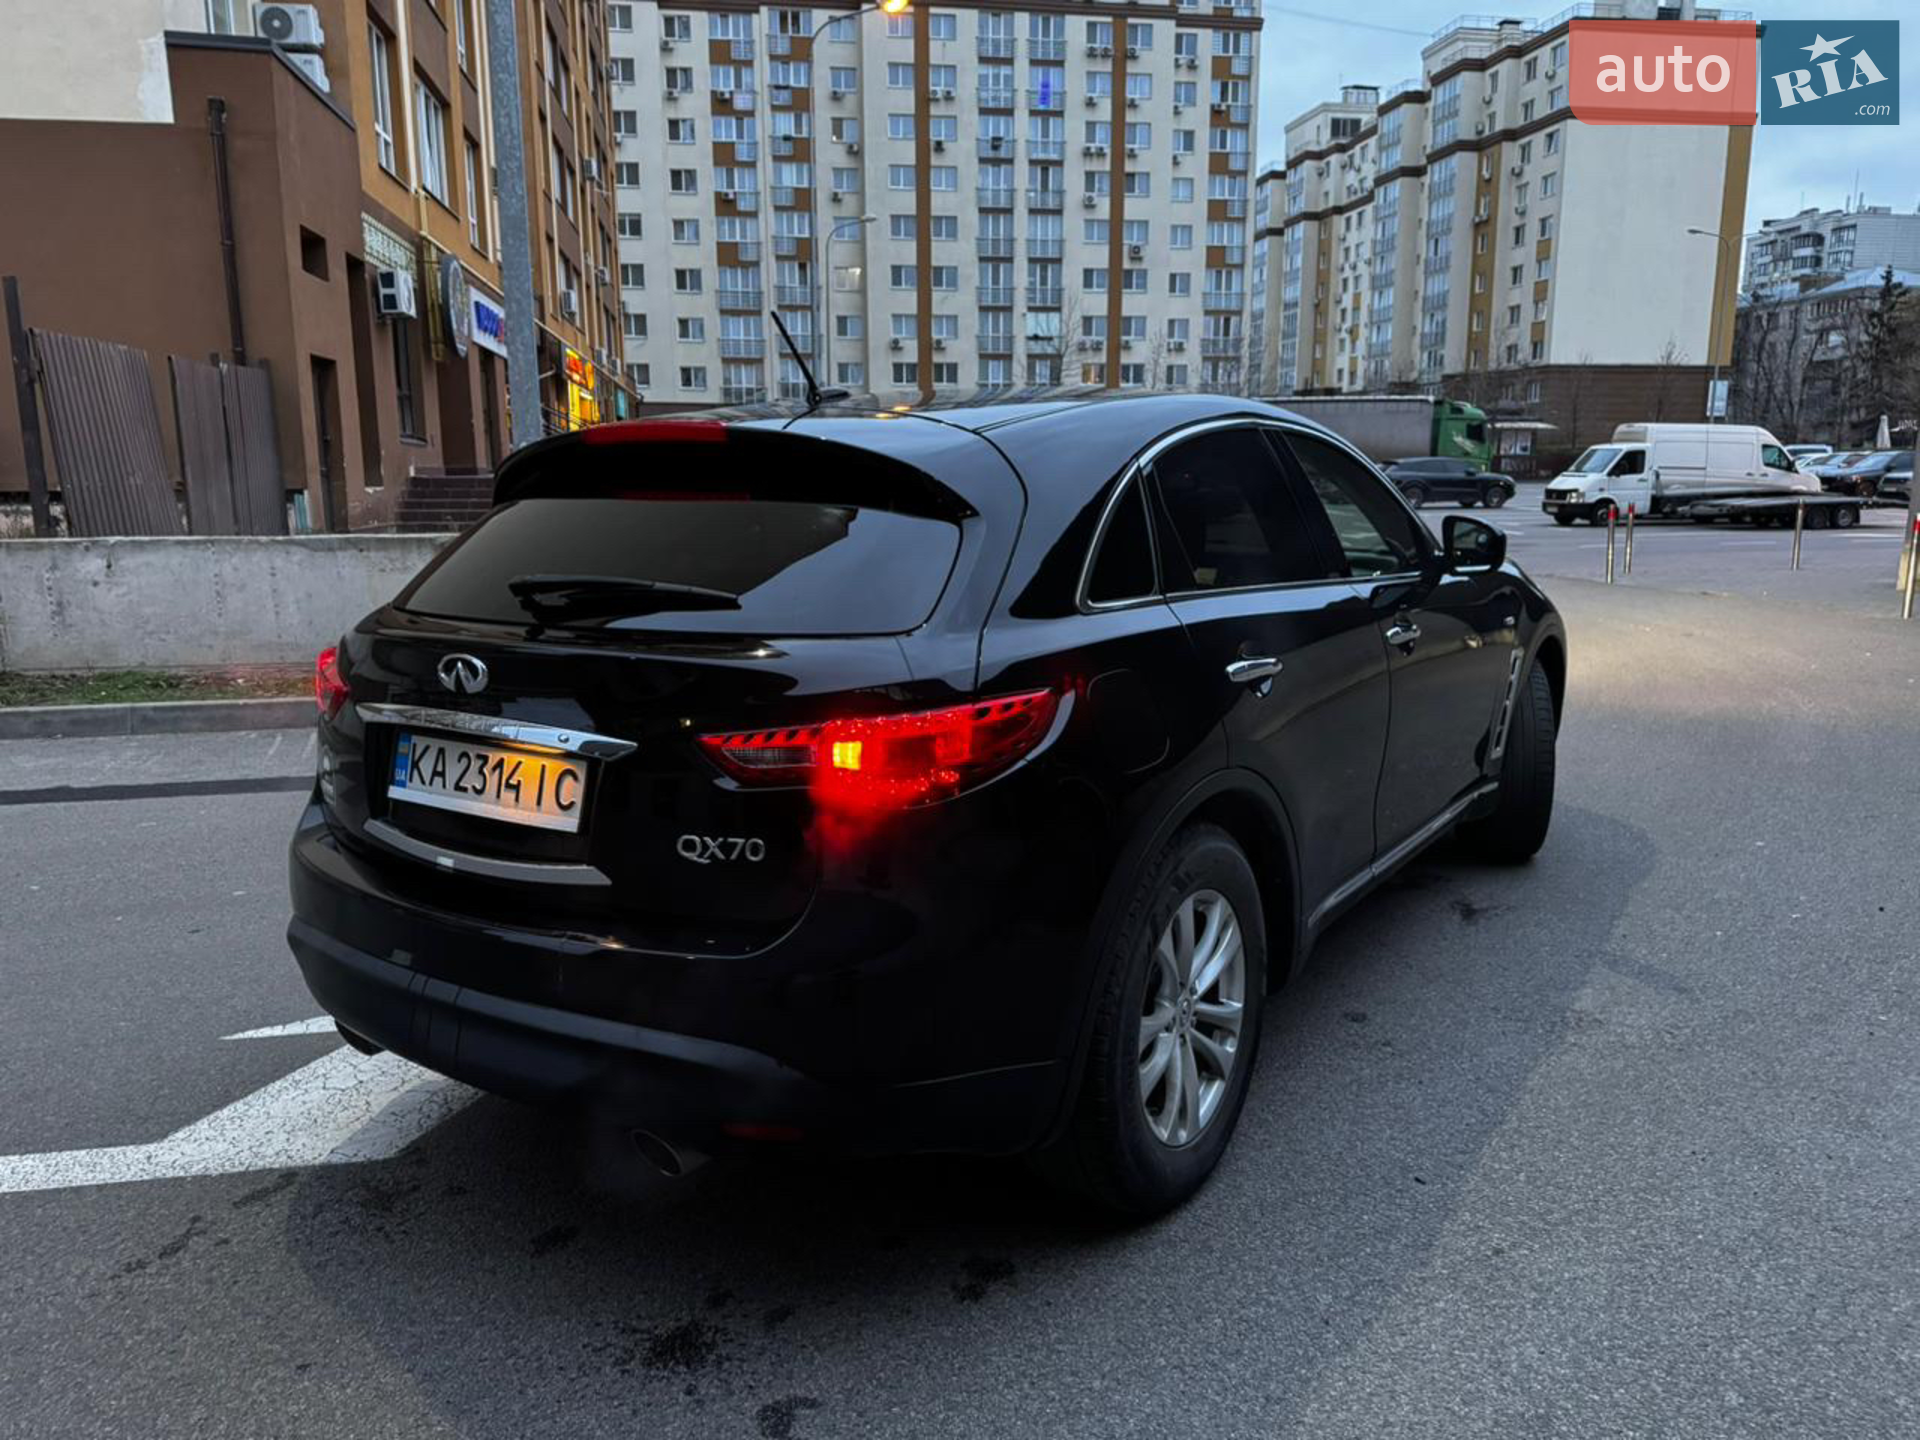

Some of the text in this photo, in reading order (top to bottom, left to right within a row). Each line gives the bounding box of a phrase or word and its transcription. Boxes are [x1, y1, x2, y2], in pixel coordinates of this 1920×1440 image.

[409, 742, 579, 811] KA 2314 IC
[676, 833, 766, 864] QX70
